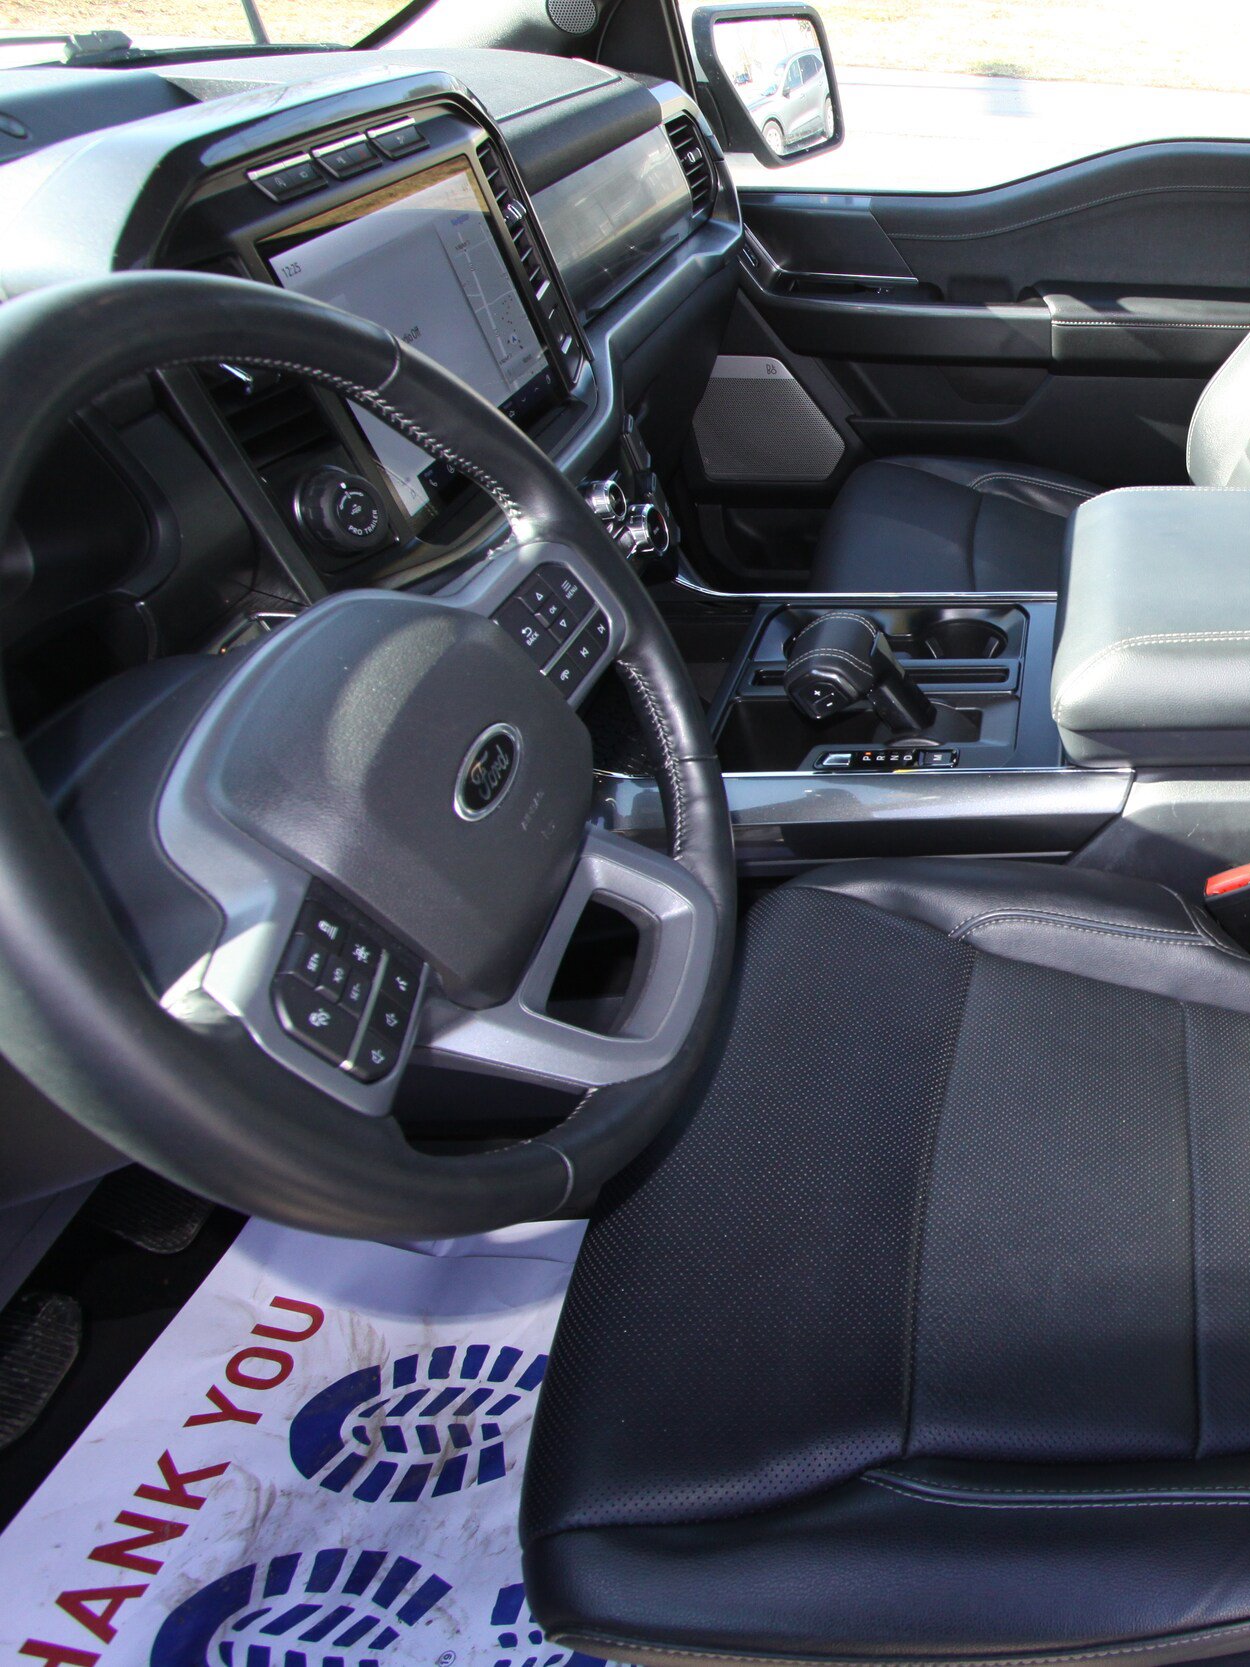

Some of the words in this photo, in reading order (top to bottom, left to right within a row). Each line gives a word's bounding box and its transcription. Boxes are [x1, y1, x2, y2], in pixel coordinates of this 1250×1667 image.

[281, 262, 302, 279] 12:25
[348, 525, 363, 535] PRO
[364, 509, 379, 535] TRAILER
[565, 585, 578, 600] MENU
[549, 606, 557, 615] OK
[526, 632, 539, 646] BACK
[470, 744, 509, 800] Ford
[183, 1296, 325, 1427] YOU
